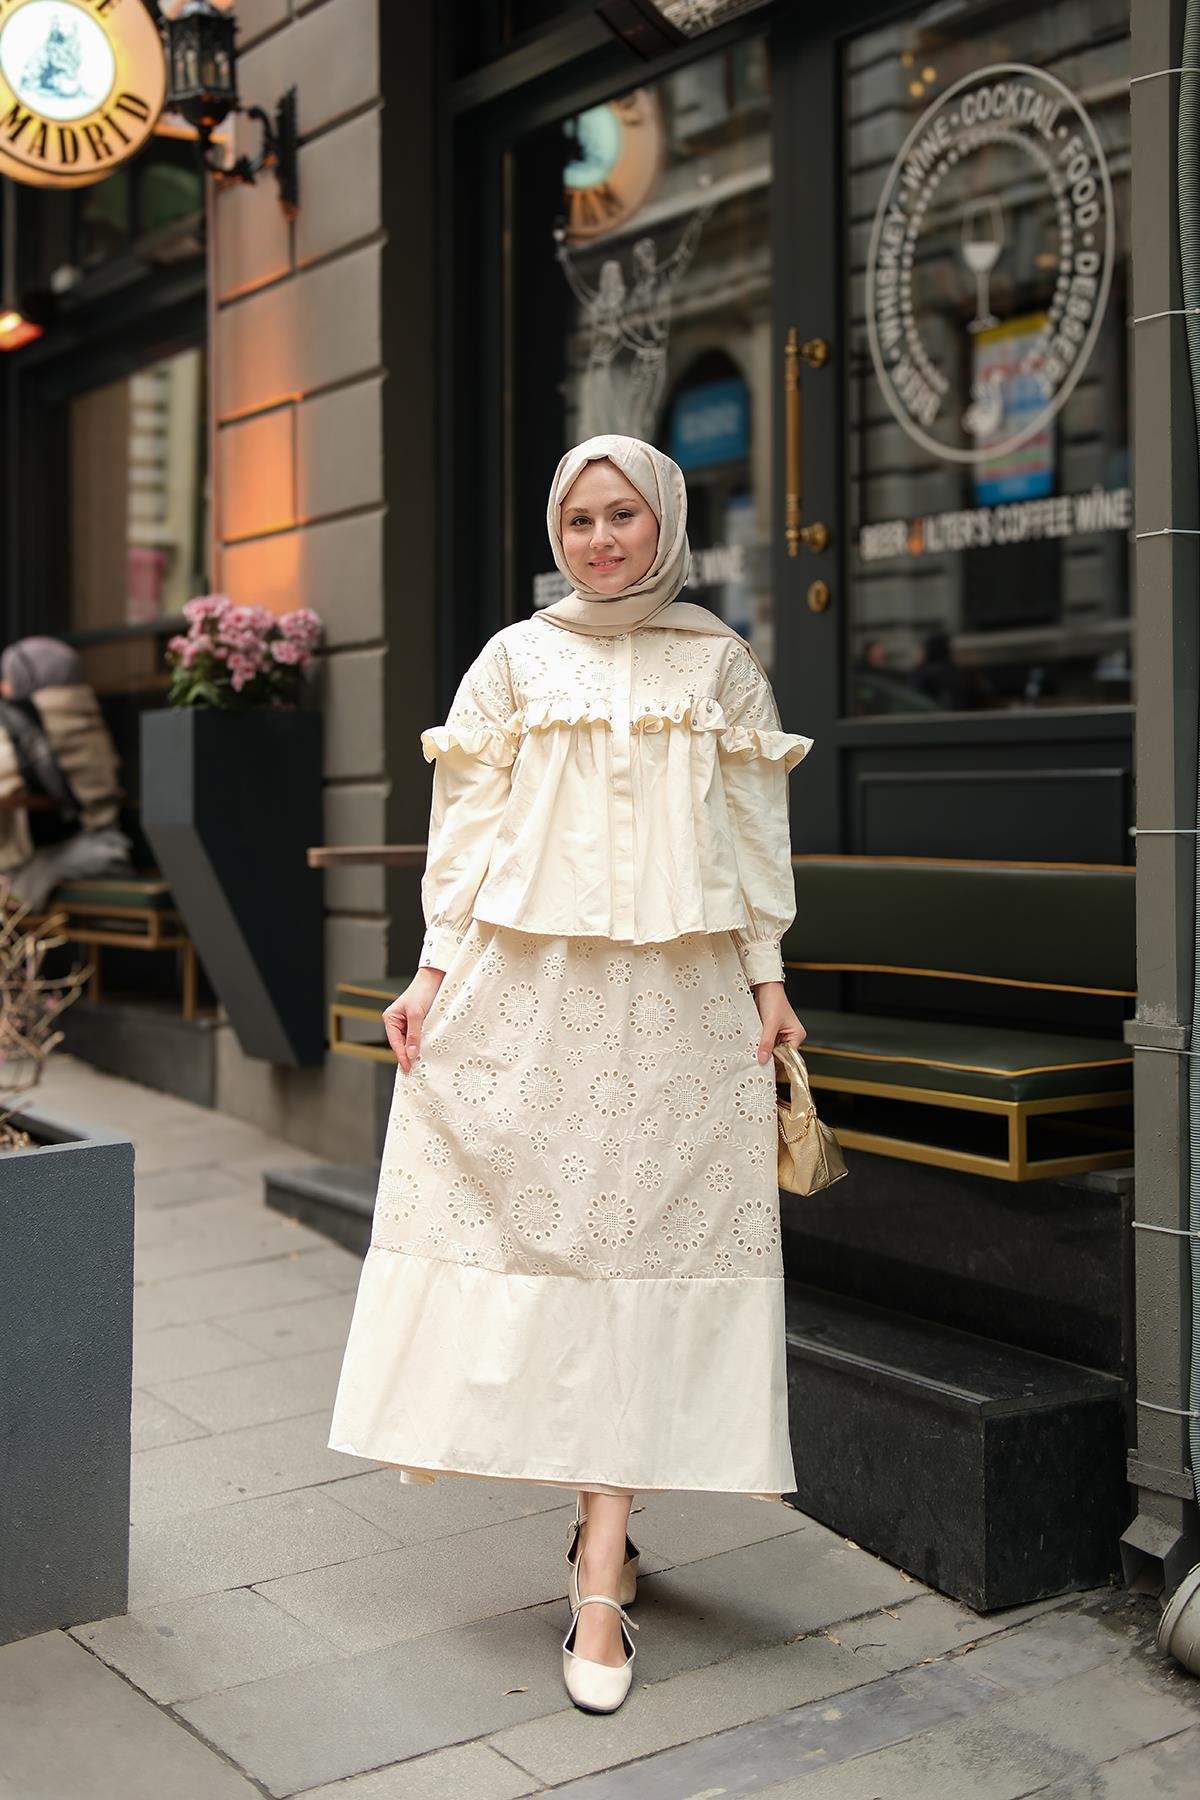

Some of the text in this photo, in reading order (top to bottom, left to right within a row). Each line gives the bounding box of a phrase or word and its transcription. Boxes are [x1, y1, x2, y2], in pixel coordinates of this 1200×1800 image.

[1, 91, 151, 165] MADRID
[901, 115, 951, 190] WINE
[960, 82, 1062, 141] COCKTAIL
[1057, 134, 1099, 229] FOOD
[993, 496, 1073, 545] COFFEE
